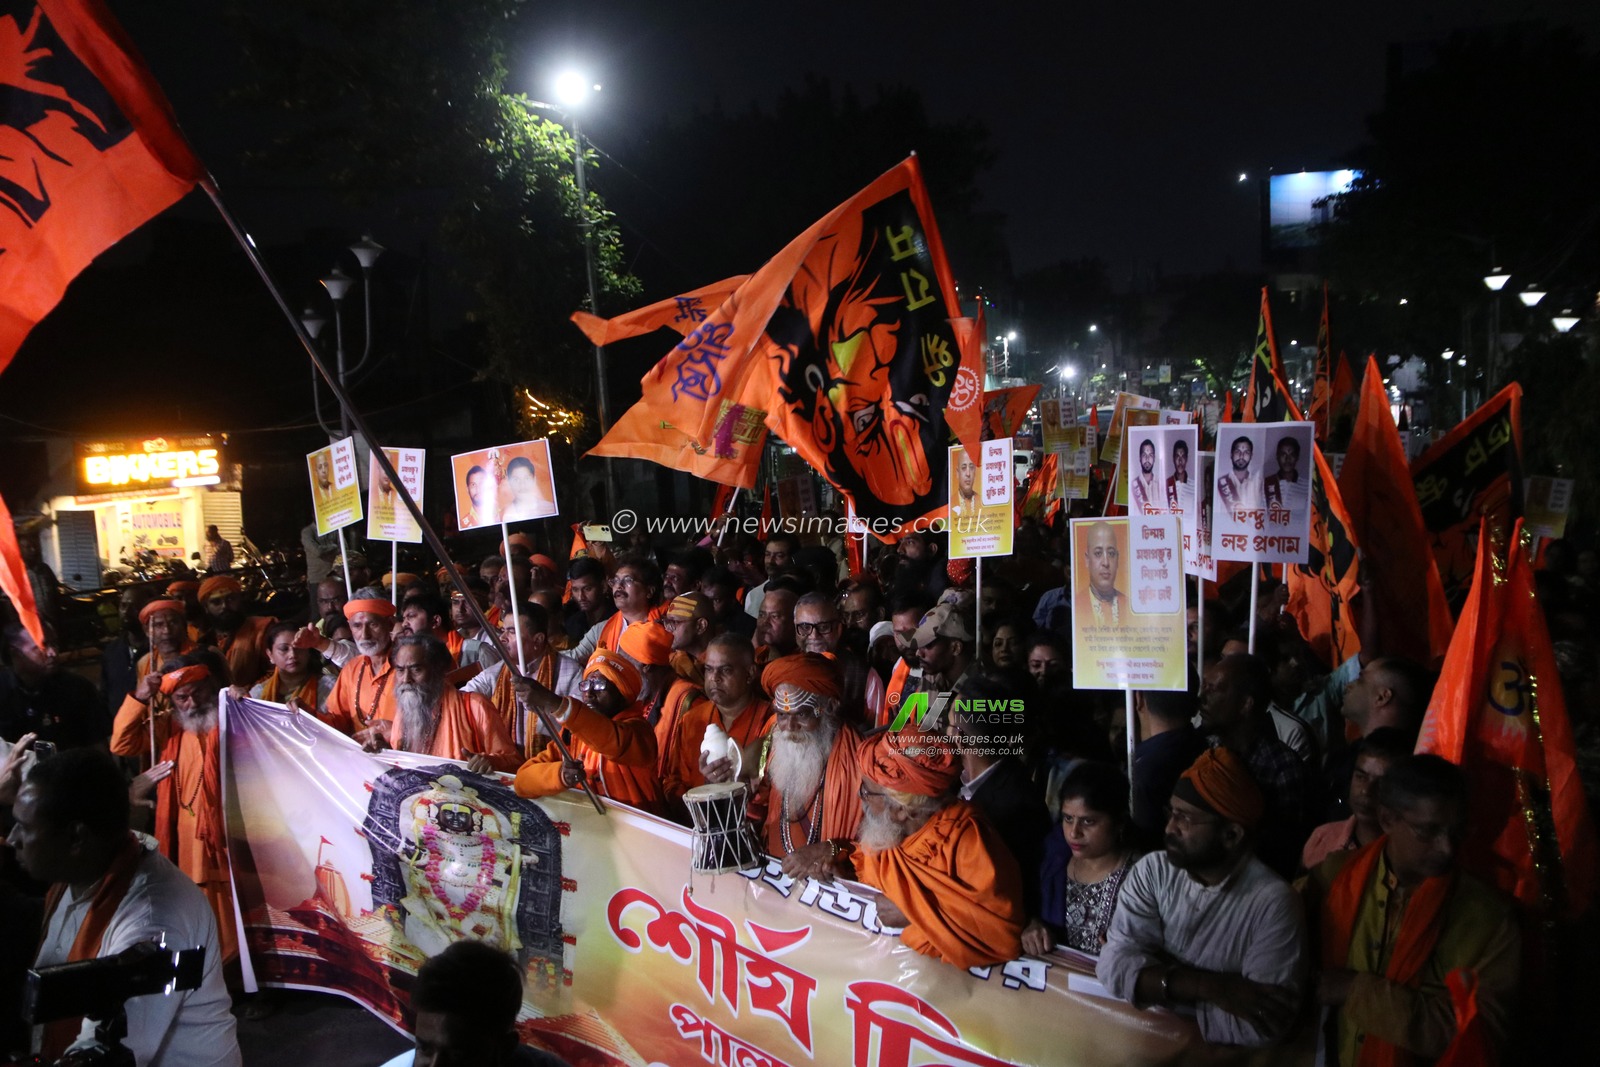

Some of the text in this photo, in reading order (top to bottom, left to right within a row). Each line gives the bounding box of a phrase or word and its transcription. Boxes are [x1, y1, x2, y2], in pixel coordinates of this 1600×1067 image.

[132, 513, 182, 529] AUTOMOBILE
[1269, 502, 1291, 526] বীর
[1142, 525, 1165, 540] চিন্ময়
[1221, 533, 1248, 552] লহ
[1253, 536, 1301, 555] প্রণাম
